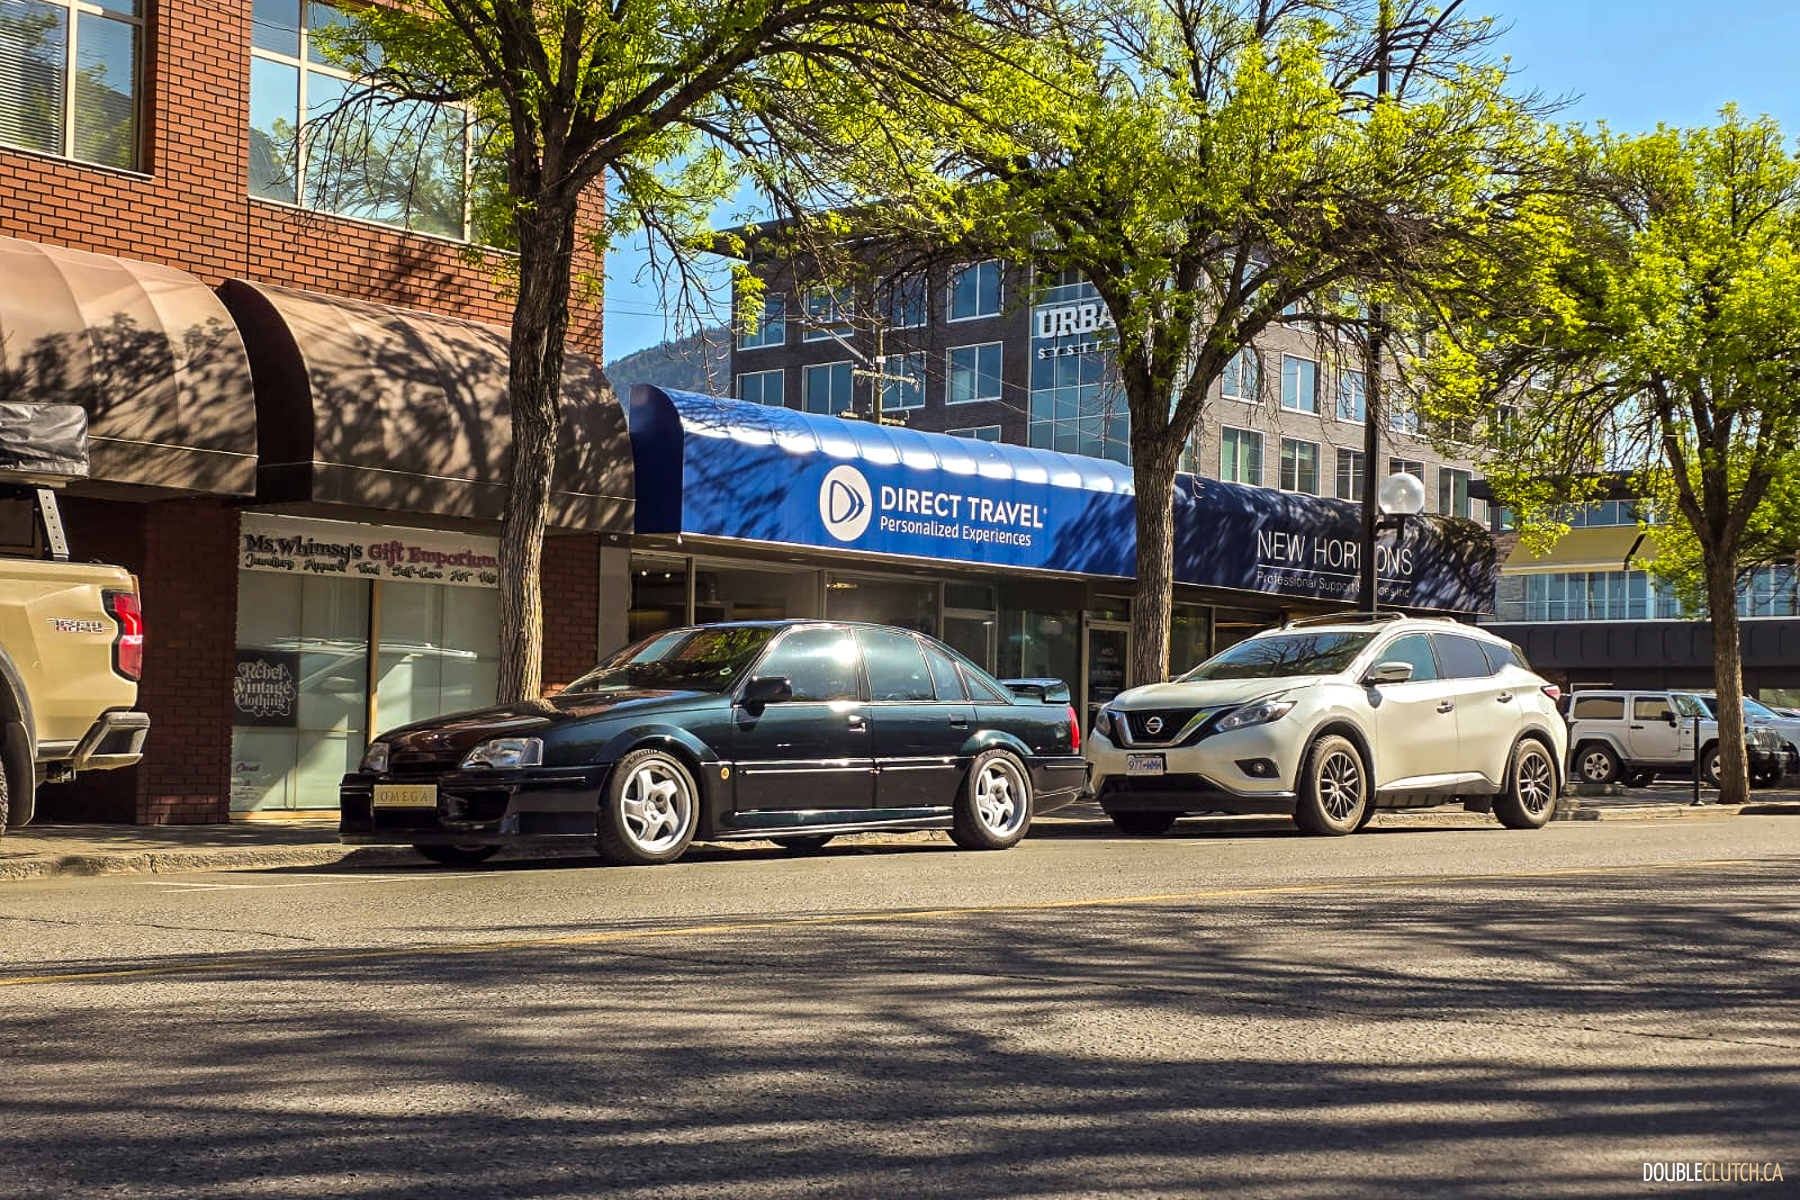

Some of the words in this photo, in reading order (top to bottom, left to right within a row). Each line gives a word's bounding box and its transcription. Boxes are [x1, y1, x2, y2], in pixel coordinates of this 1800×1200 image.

[1036, 301, 1117, 338] URBA
[1038, 340, 1112, 359] SYST
[881, 486, 961, 517] DIRECT
[967, 496, 1044, 528] TRAVEL
[880, 515, 959, 539] Personalized
[962, 525, 1032, 547] Experiences
[367, 540, 404, 568] Gift
[1257, 529, 1306, 562] NEW
[1313, 536, 1413, 576] HORIONS
[1257, 571, 1317, 589] Professional
[1318, 577, 1355, 595] Support
[234, 677, 290, 697] Vintage
[380, 790, 428, 802] OMEGA
